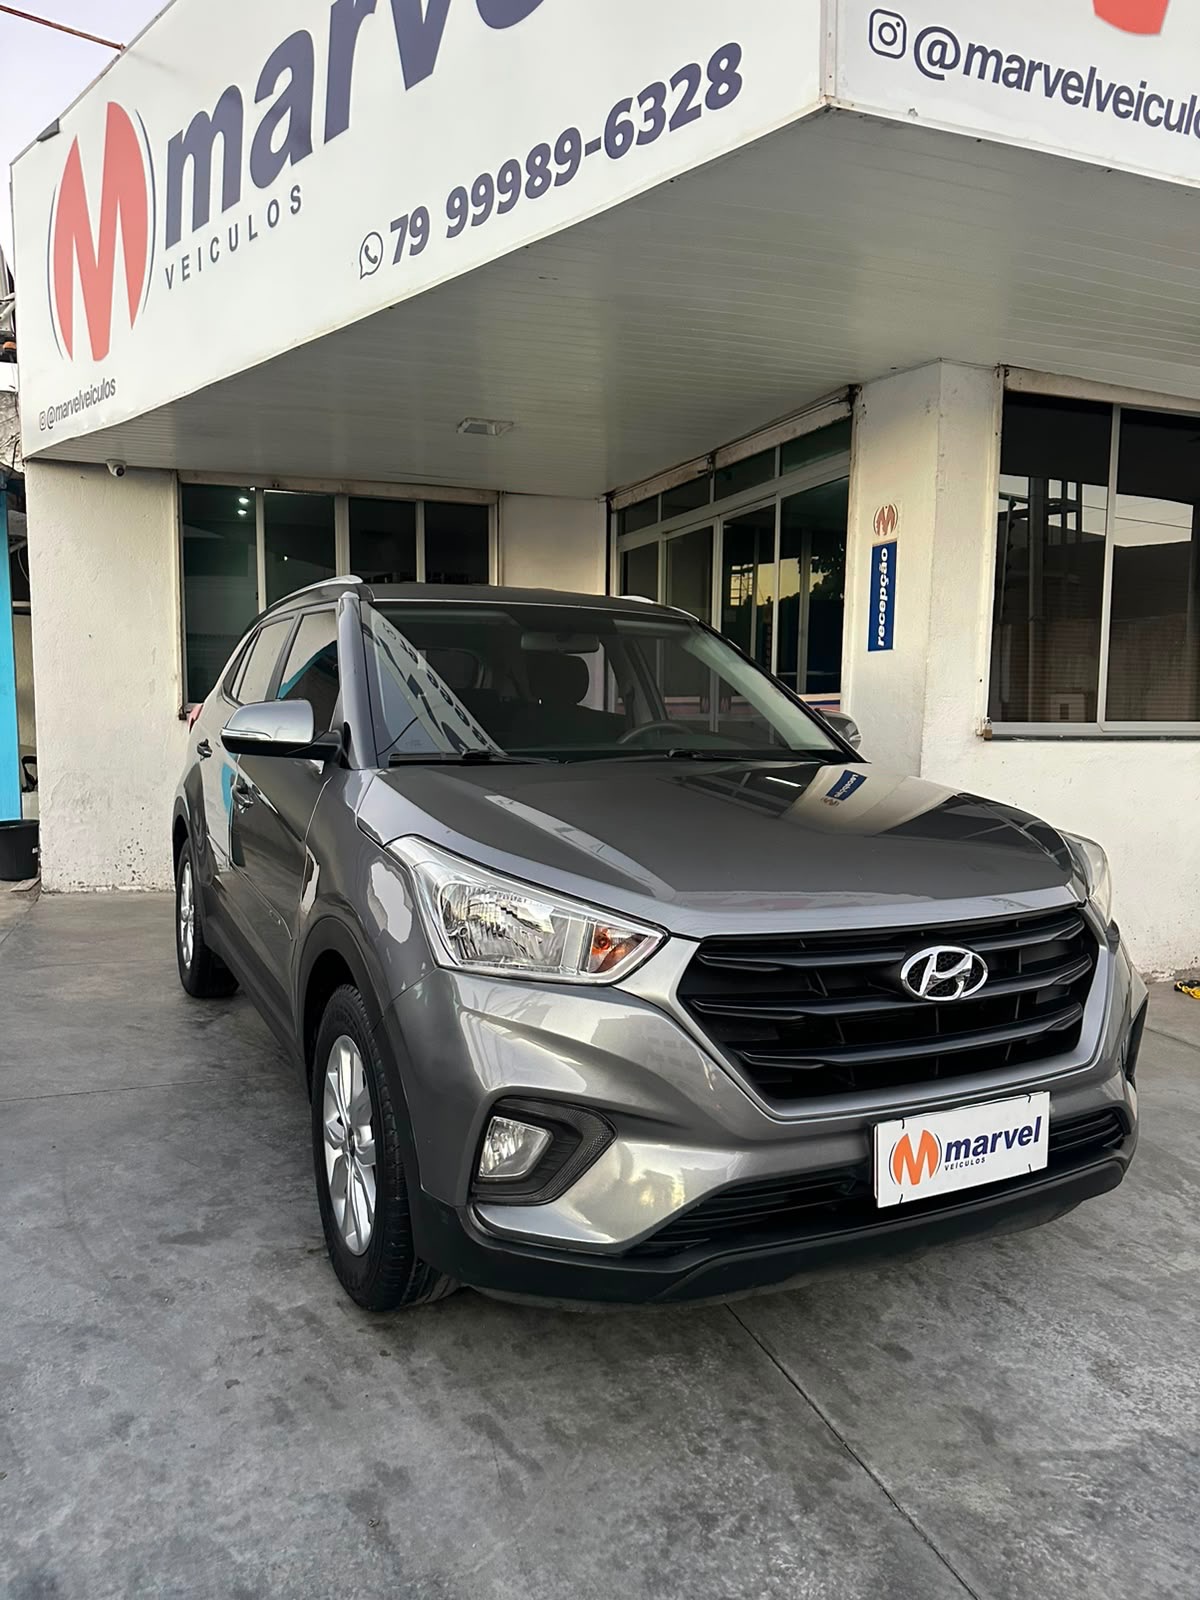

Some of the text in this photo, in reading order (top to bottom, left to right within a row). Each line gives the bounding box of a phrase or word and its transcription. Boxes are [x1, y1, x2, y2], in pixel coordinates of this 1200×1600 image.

[389, 41, 743, 265] 79 99989-6328
[165, 183, 302, 289] VEICULOS
[47, 377, 116, 430] @marvelveiculos
[876, 547, 889, 647] recepção
[944, 1115, 1042, 1163] marvel
[944, 1156, 986, 1171] VEICULOS
